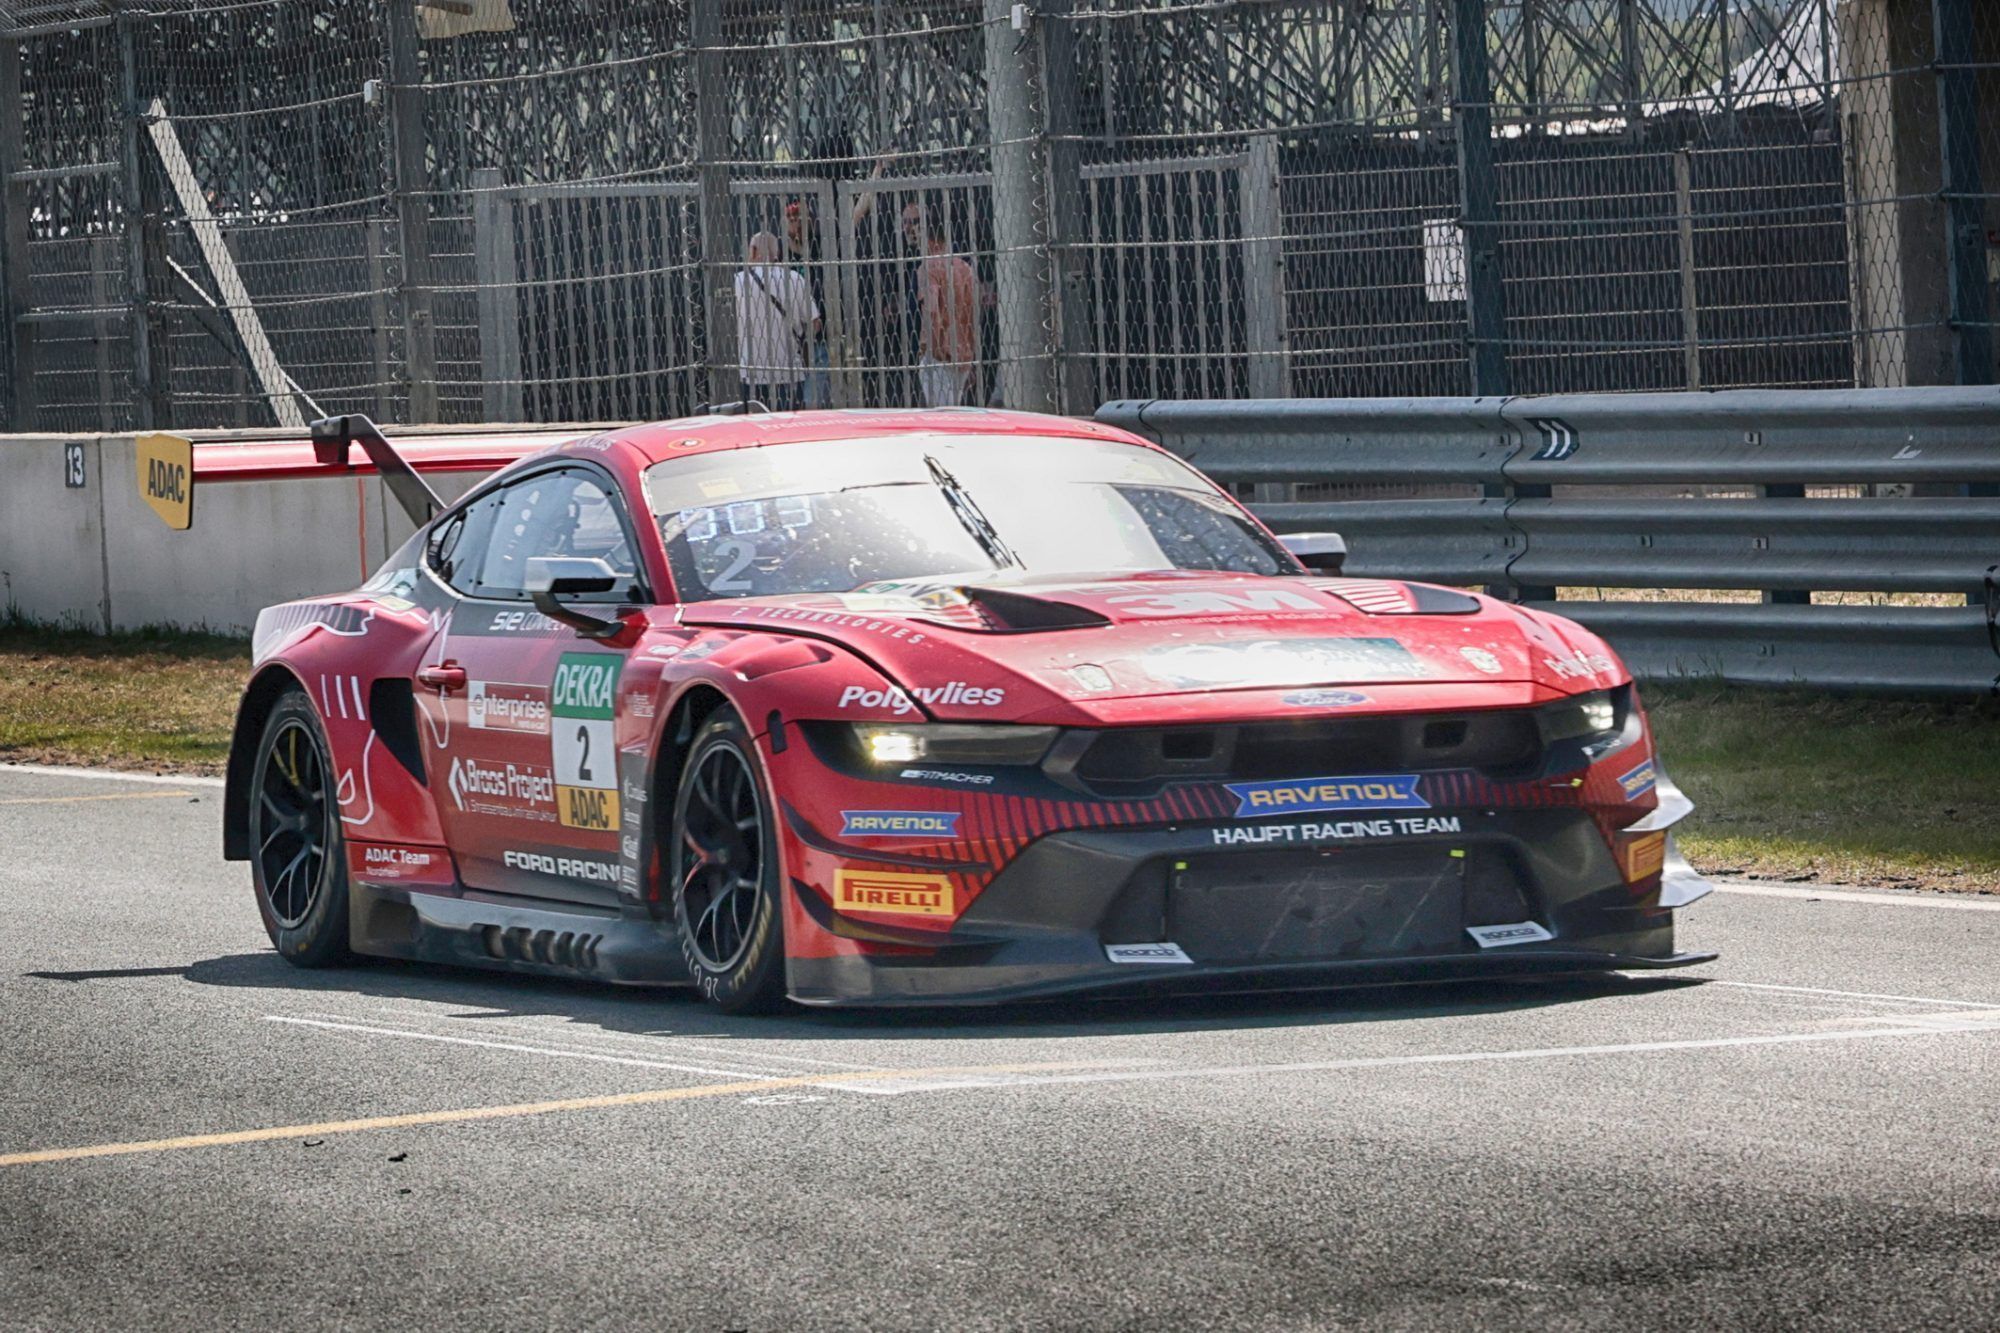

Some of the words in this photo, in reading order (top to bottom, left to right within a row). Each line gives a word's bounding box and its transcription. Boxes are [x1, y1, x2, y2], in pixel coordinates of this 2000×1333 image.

[67, 446, 85, 486] 13
[148, 458, 185, 504] ADAC
[709, 540, 757, 592] 2
[1105, 590, 1327, 617] 3M
[758, 607, 925, 645] TECHNOLOGIES
[553, 664, 615, 709] DEKRA
[838, 682, 1004, 715] Polyvlies
[577, 726, 593, 781] 2
[466, 759, 507, 796] Broos
[506, 764, 555, 807] Project
[1248, 783, 1410, 807] RAVENOL
[568, 788, 610, 830] ADAC
[849, 816, 948, 831] RAVENOL
[1213, 825, 1296, 844] HAUPT
[1301, 820, 1393, 840] RACING
[1395, 817, 1462, 834] TEAM
[365, 848, 397, 863] ADAC
[399, 850, 431, 865] Team
[504, 850, 556, 875] FORD
[842, 878, 942, 908] PIRELLI
